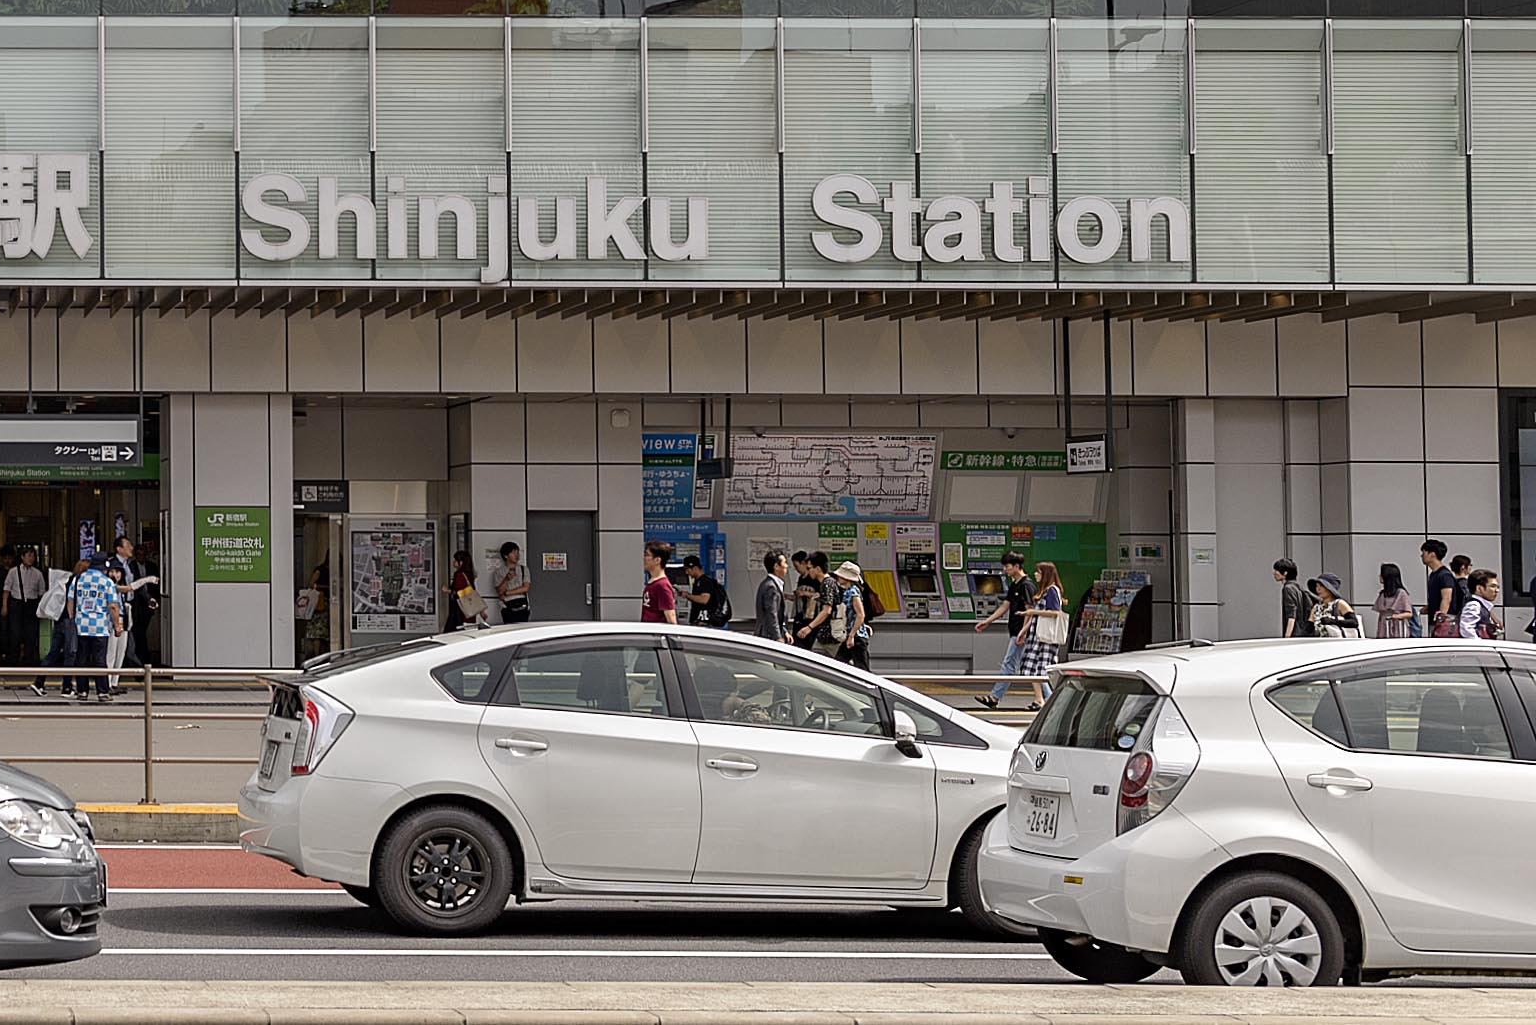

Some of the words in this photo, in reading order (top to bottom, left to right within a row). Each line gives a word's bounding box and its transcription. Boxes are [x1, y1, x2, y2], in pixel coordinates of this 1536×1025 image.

[240, 173, 710, 284] Shinjuku
[810, 174, 1193, 264] Station
[207, 513, 224, 524] JR
[201, 537, 265, 549] 甲州街道改札
